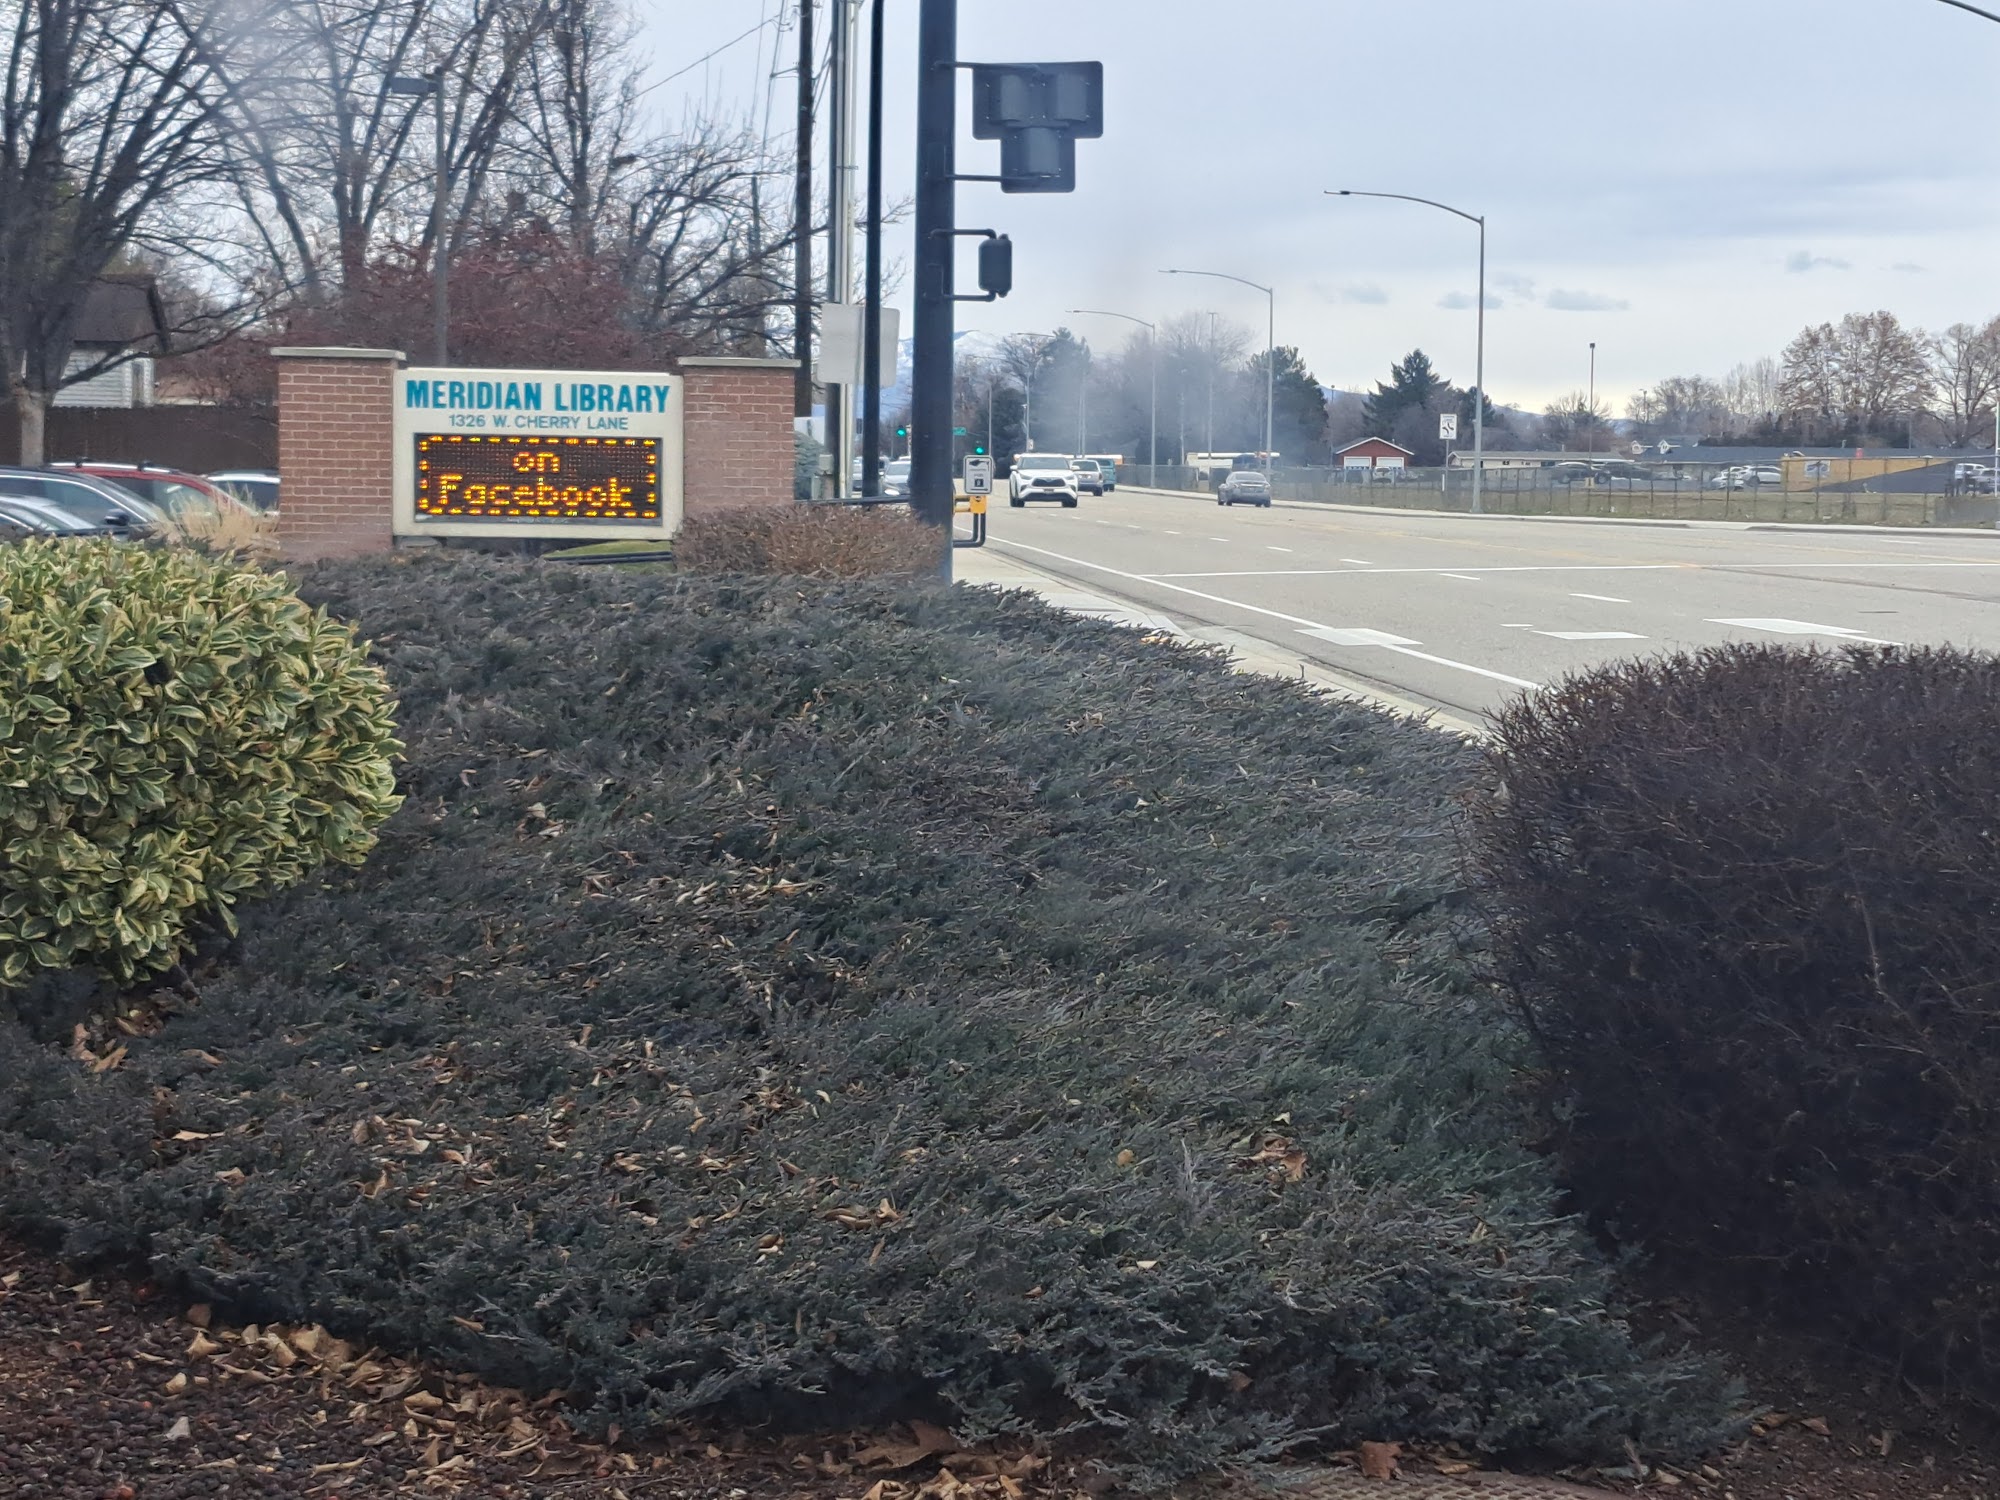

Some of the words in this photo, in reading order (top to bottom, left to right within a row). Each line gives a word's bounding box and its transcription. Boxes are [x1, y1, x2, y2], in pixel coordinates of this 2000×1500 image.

[406, 380, 541, 411] MERIDIAN
[554, 383, 670, 413] LIBRARY
[448, 414, 486, 428] 1326
[492, 415, 511, 428] W.
[514, 415, 580, 429] CHERRY
[587, 416, 629, 430] LANE
[512, 452, 561, 473] on
[437, 473, 632, 508] Facebook
